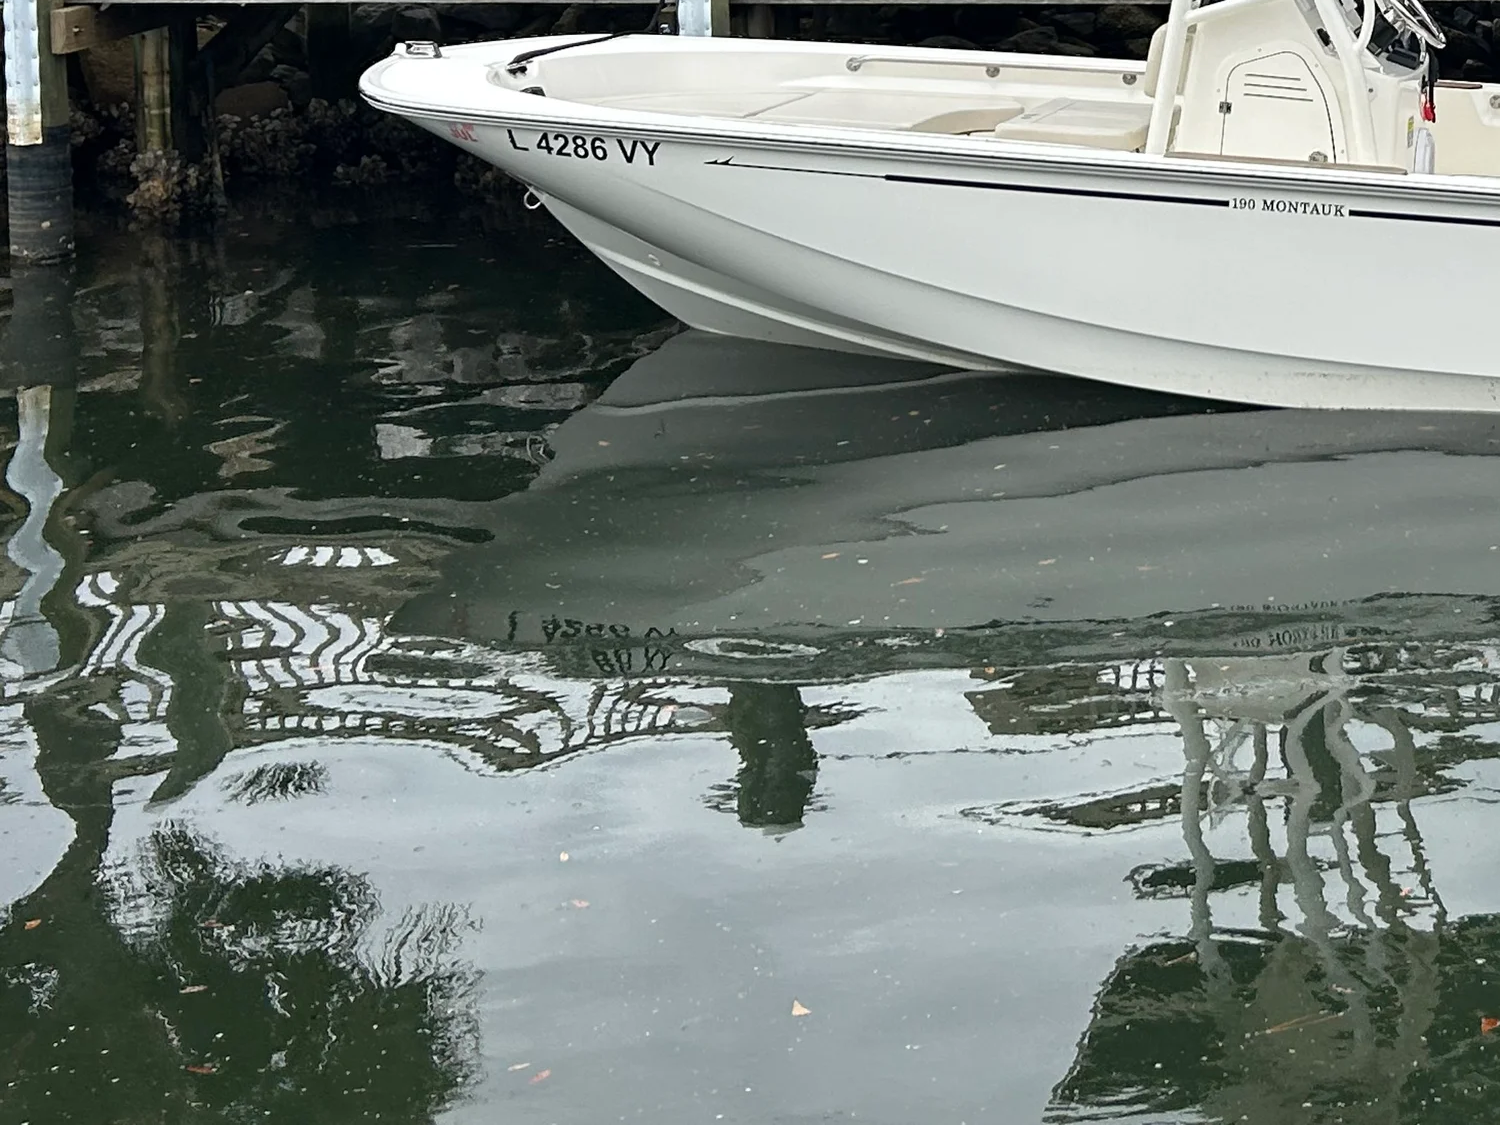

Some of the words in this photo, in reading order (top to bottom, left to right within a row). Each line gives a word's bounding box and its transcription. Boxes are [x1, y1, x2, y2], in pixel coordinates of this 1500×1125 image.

[536, 132, 608, 161] 4286
[616, 138, 661, 166] VY
[1232, 197, 1256, 210] 190
[1261, 199, 1346, 218] MONTAUK
